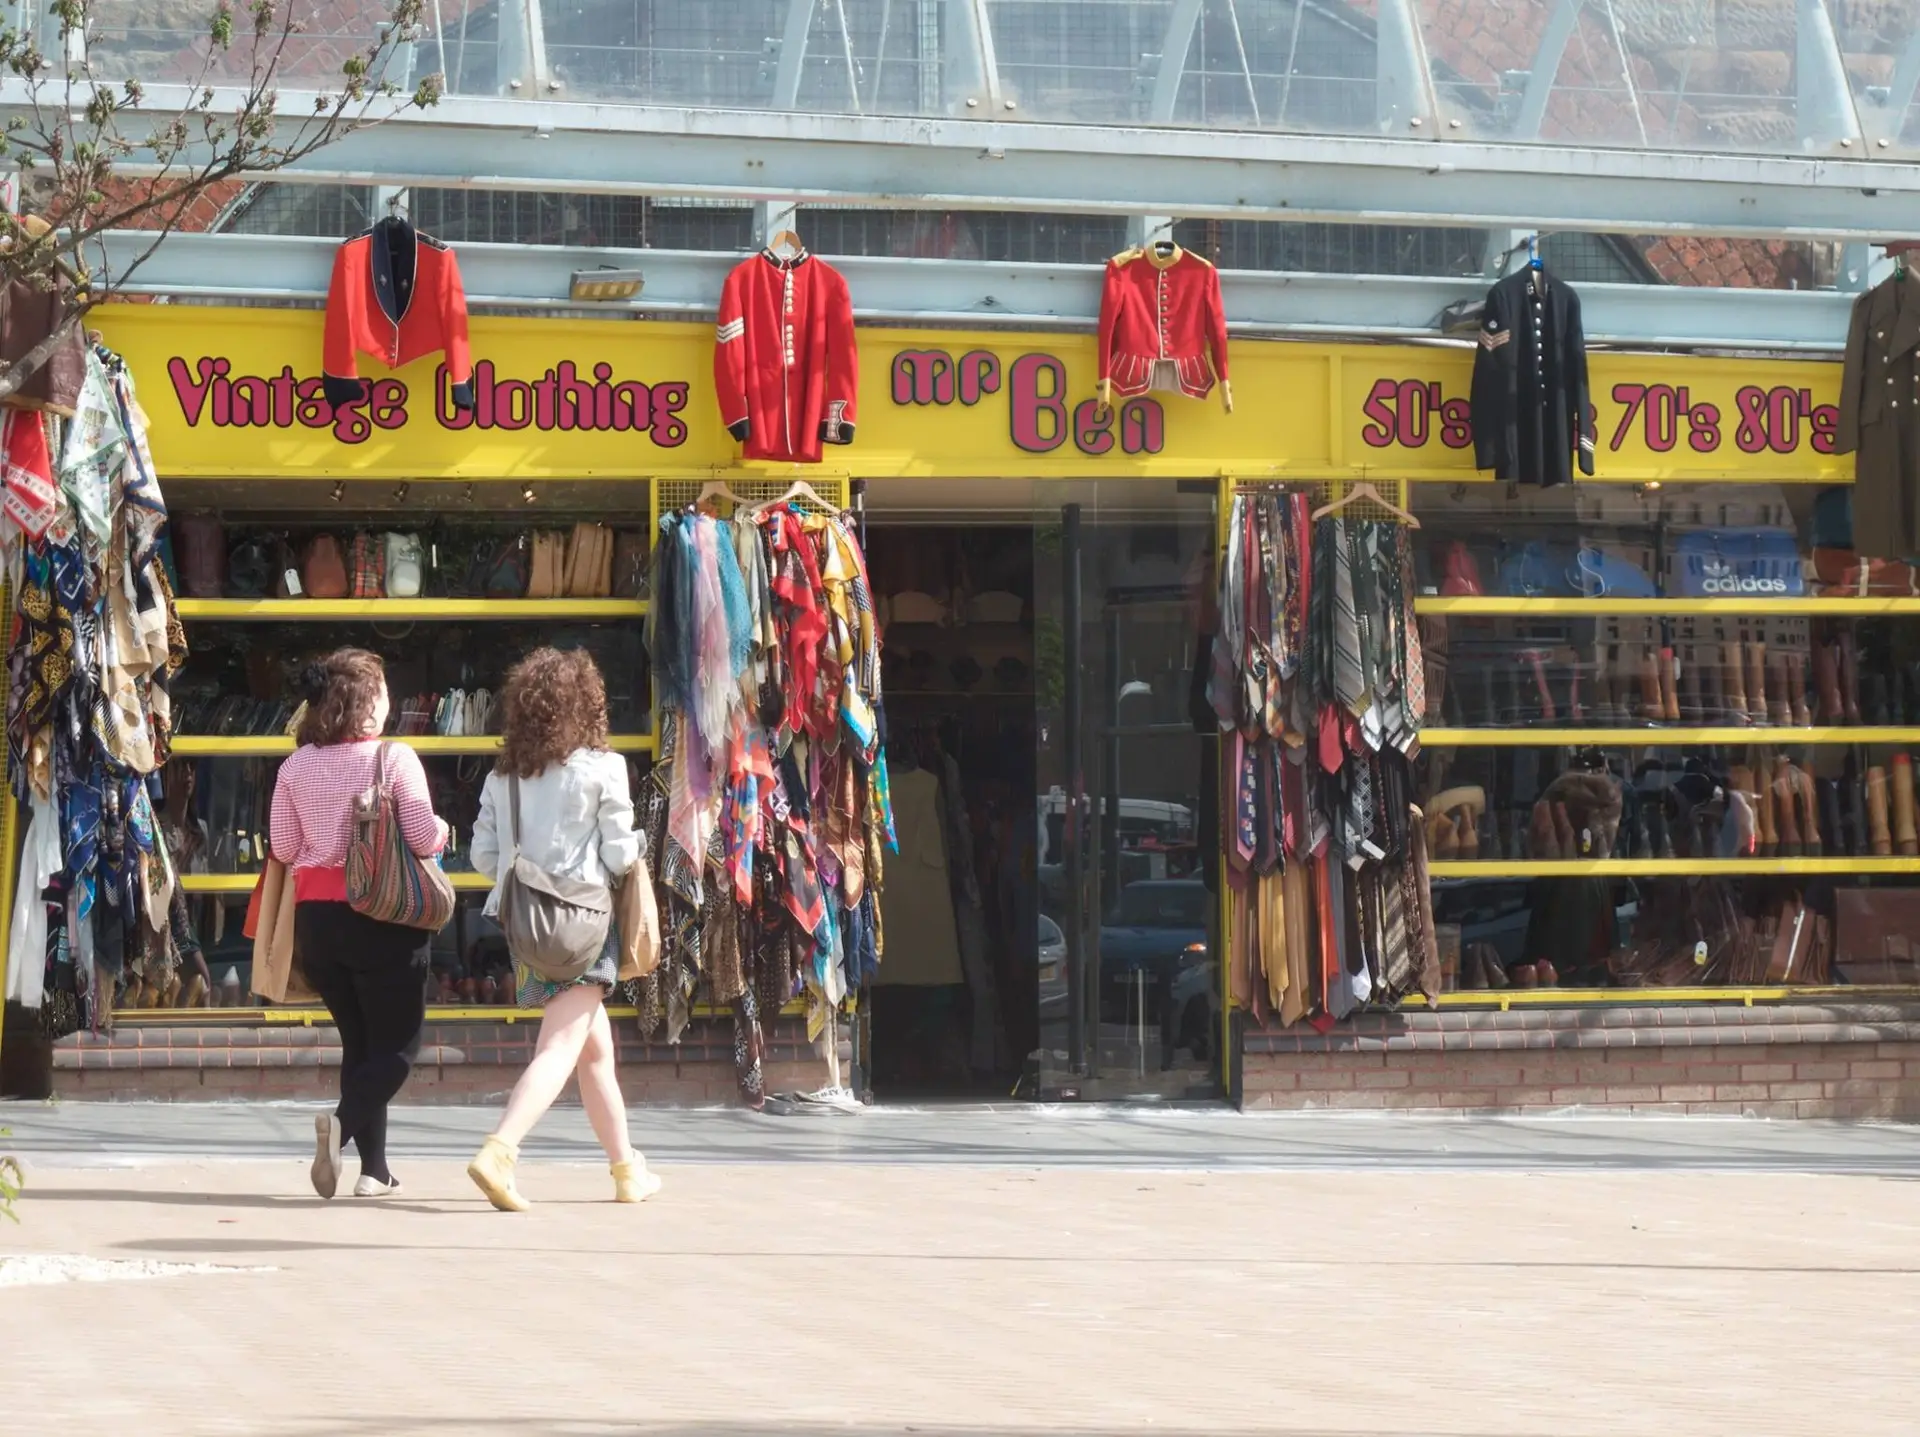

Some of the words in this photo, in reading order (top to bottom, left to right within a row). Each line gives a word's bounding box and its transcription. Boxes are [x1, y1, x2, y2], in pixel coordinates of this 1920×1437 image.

[167, 356, 409, 444] Vintage
[435, 359, 690, 448] Clothing
[1009, 352, 1164, 455] Ben
[1362, 378, 1474, 449] 50's
[1609, 383, 1721, 453] 70's
[1734, 385, 1841, 455] 80's
[1702, 575, 1787, 593] adidas
